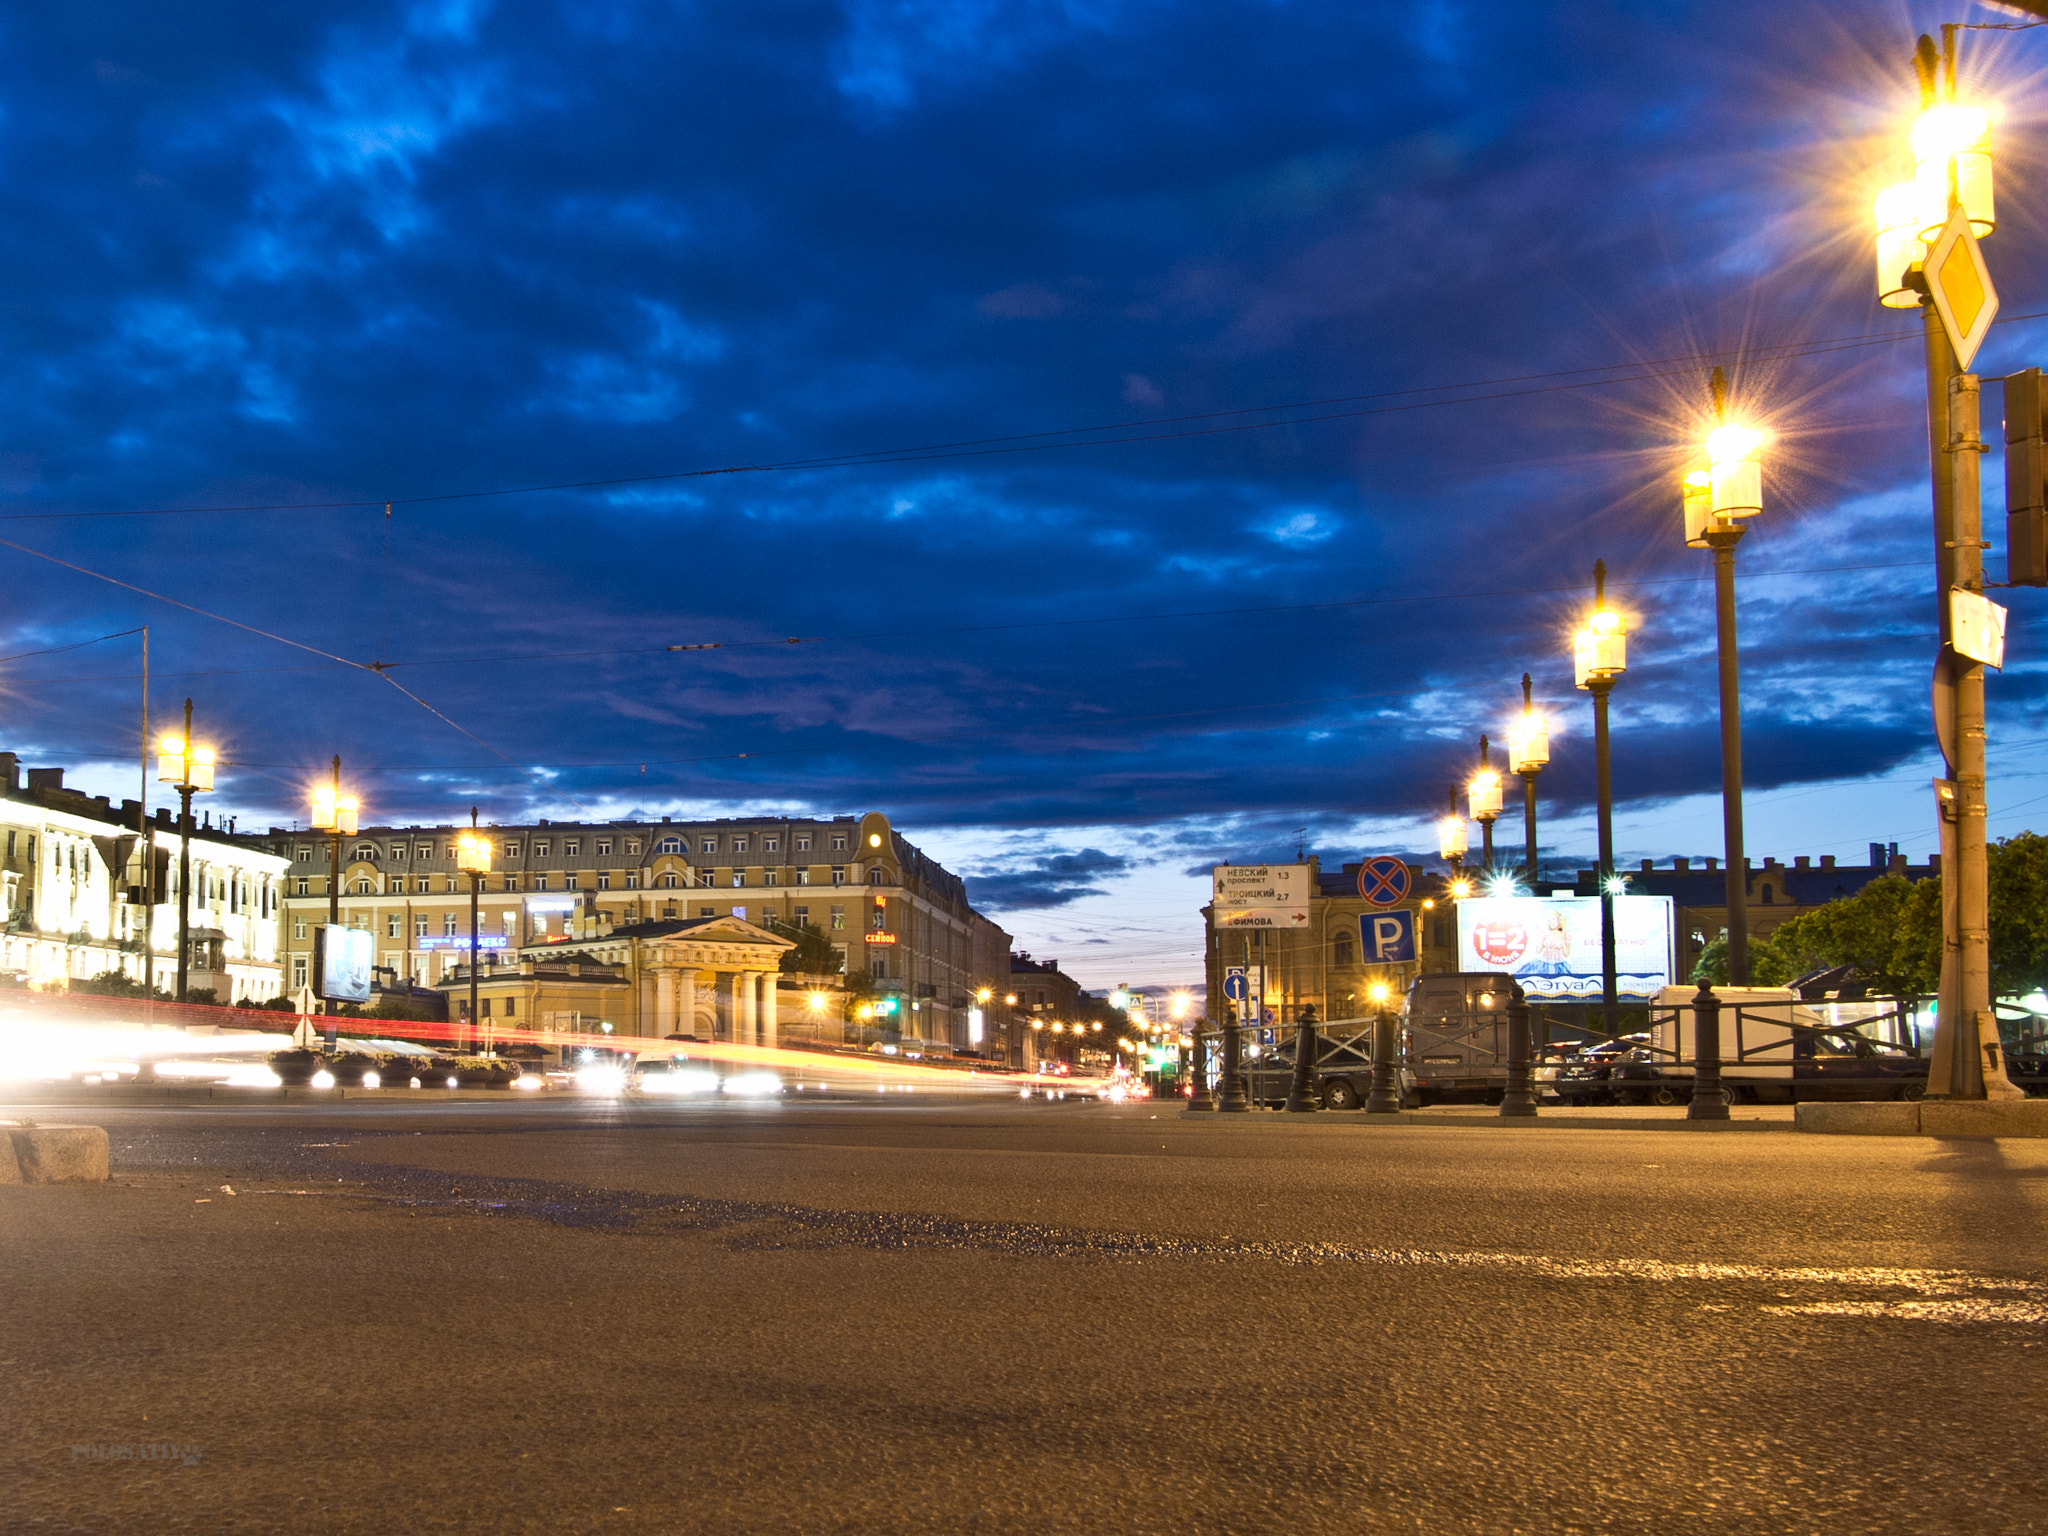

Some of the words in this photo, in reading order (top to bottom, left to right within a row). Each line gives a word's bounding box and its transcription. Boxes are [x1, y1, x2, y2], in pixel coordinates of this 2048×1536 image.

[1227, 868, 1268, 877] НЕВСКИЙ
[1278, 872, 1289, 880] 1.3
[1227, 877, 1265, 885] проспект
[1228, 888, 1275, 898] ТРОИЦКИЙ
[1276, 893, 1289, 901] 2.7
[1228, 918, 1272, 926] ЕФИМОВА
[1475, 927, 1525, 950] 1=2
